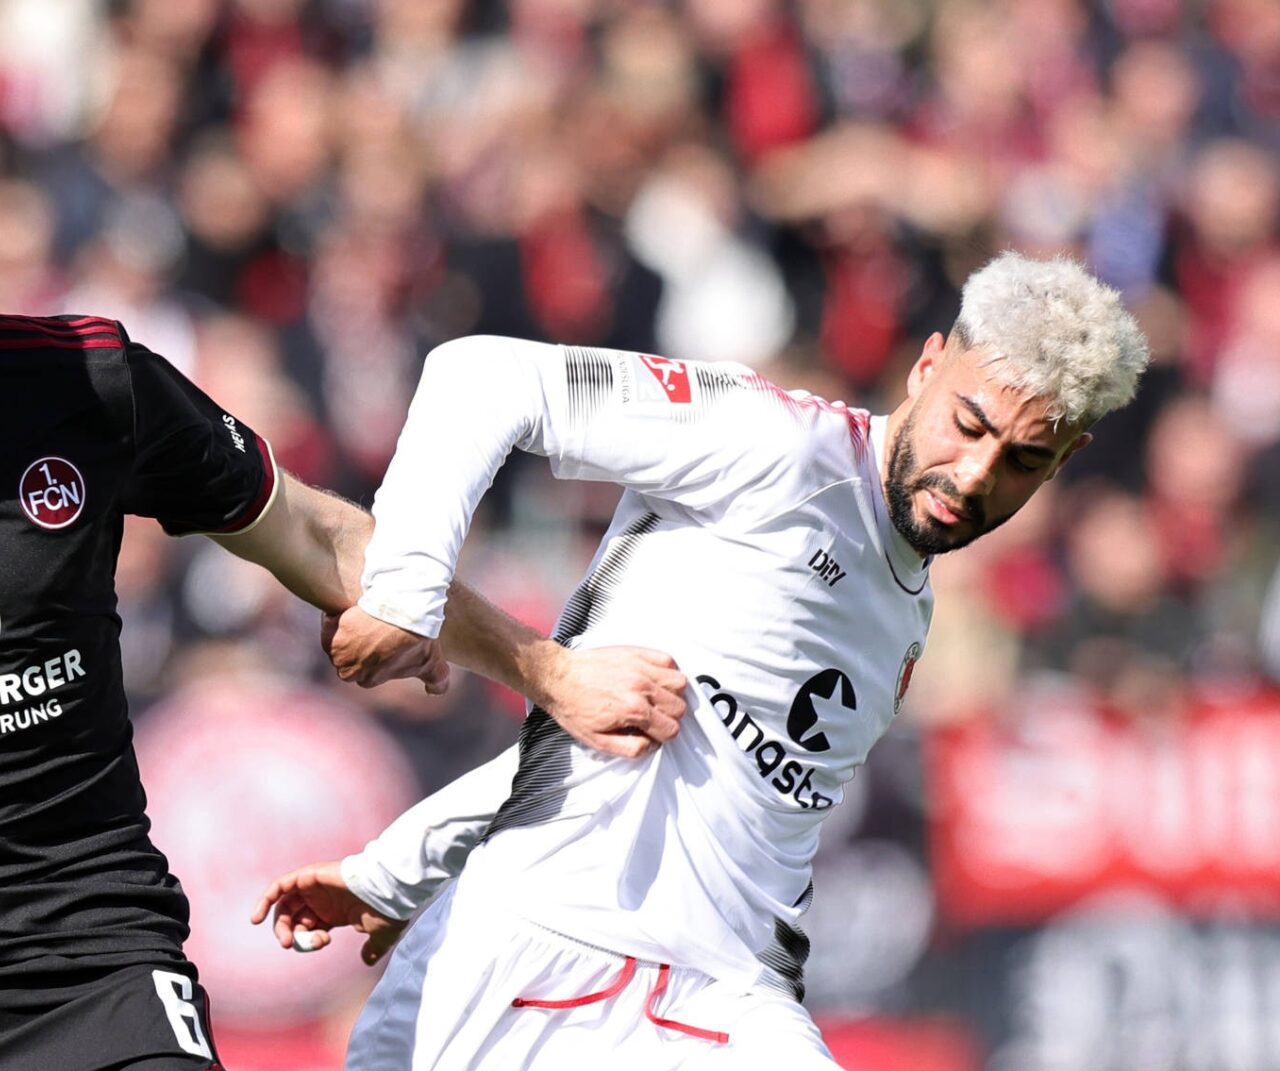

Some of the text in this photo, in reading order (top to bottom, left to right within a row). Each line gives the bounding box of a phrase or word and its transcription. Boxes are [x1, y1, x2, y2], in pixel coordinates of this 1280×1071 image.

[38, 462, 58, 486] 1.
[28, 481, 81, 516] FCN
[151, 969, 213, 1061] 6
